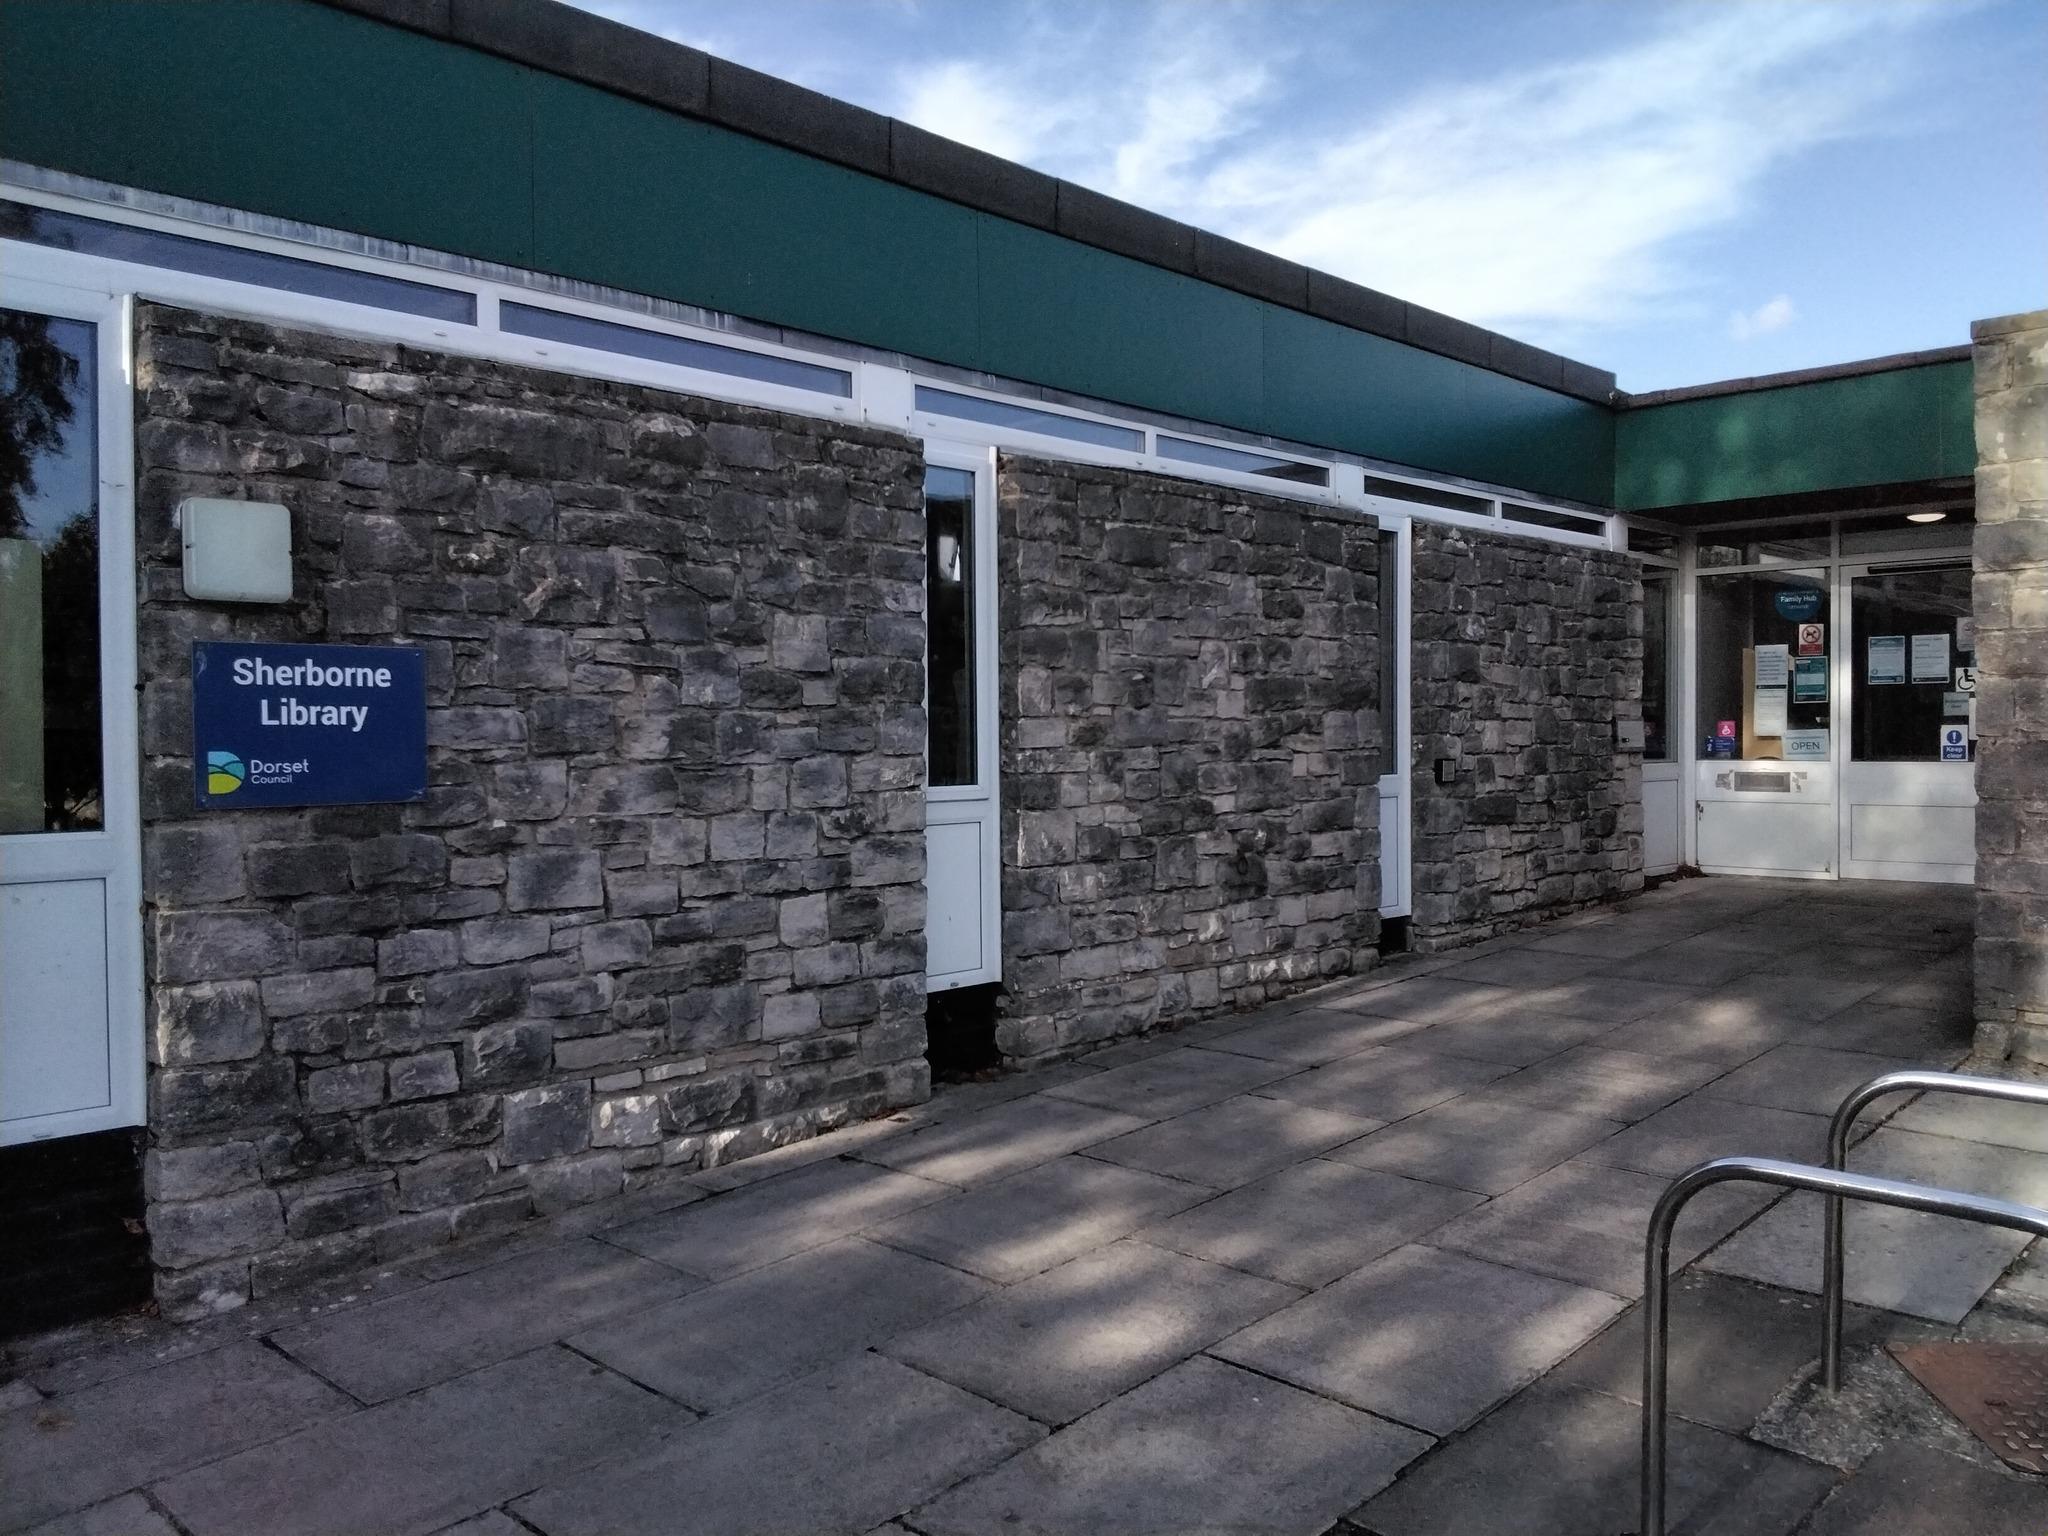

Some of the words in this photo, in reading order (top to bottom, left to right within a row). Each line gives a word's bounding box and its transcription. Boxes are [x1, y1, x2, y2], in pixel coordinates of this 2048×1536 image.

[1780, 595, 1802, 604] Family
[1803, 594, 1817, 602] Hub
[232, 657, 392, 687] Sherborne
[260, 698, 368, 732] Library
[1791, 741, 1820, 751] OPEN
[1945, 745, 1963, 753] Keep
[250, 758, 309, 774] Dorset
[251, 773, 293, 785] Council
